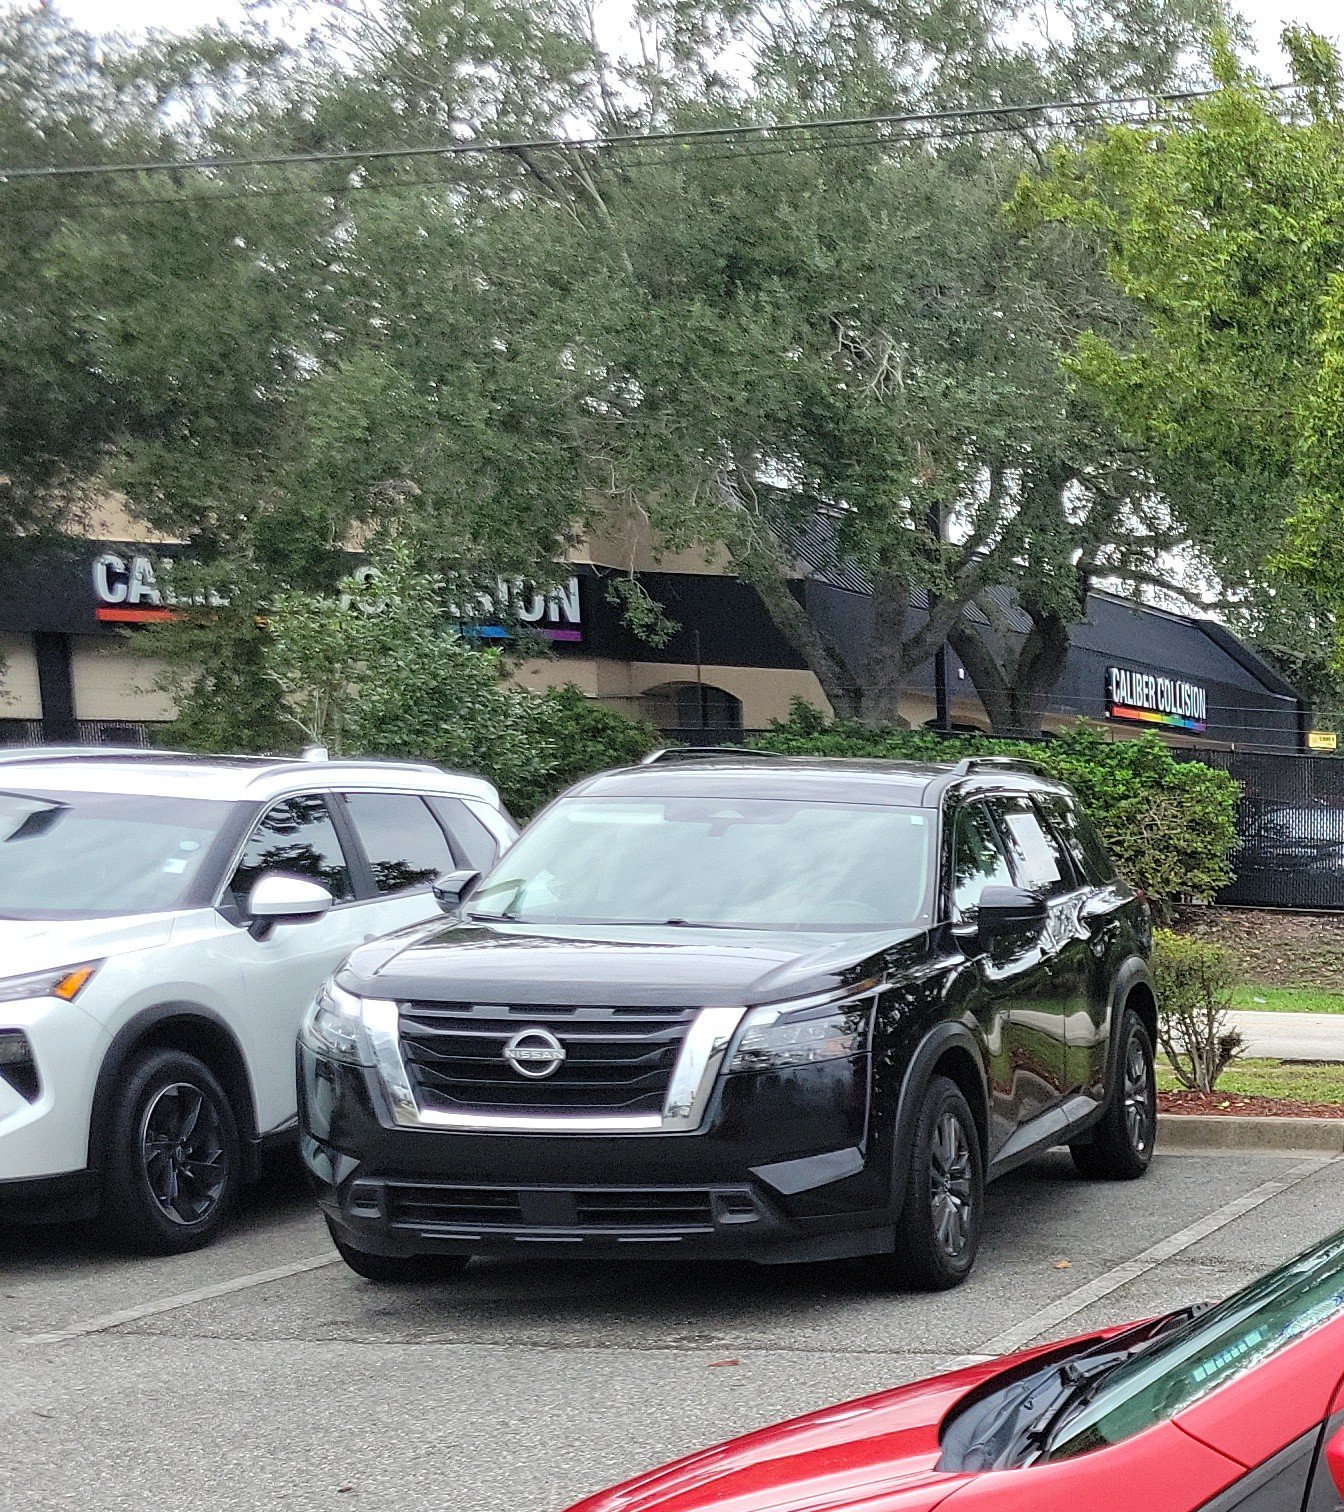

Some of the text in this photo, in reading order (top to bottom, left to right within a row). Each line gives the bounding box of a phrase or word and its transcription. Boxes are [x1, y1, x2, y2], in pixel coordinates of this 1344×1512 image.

[1111, 667, 1207, 720] CALIBER COLLISION
[505, 1049, 565, 1060] NISSAN
